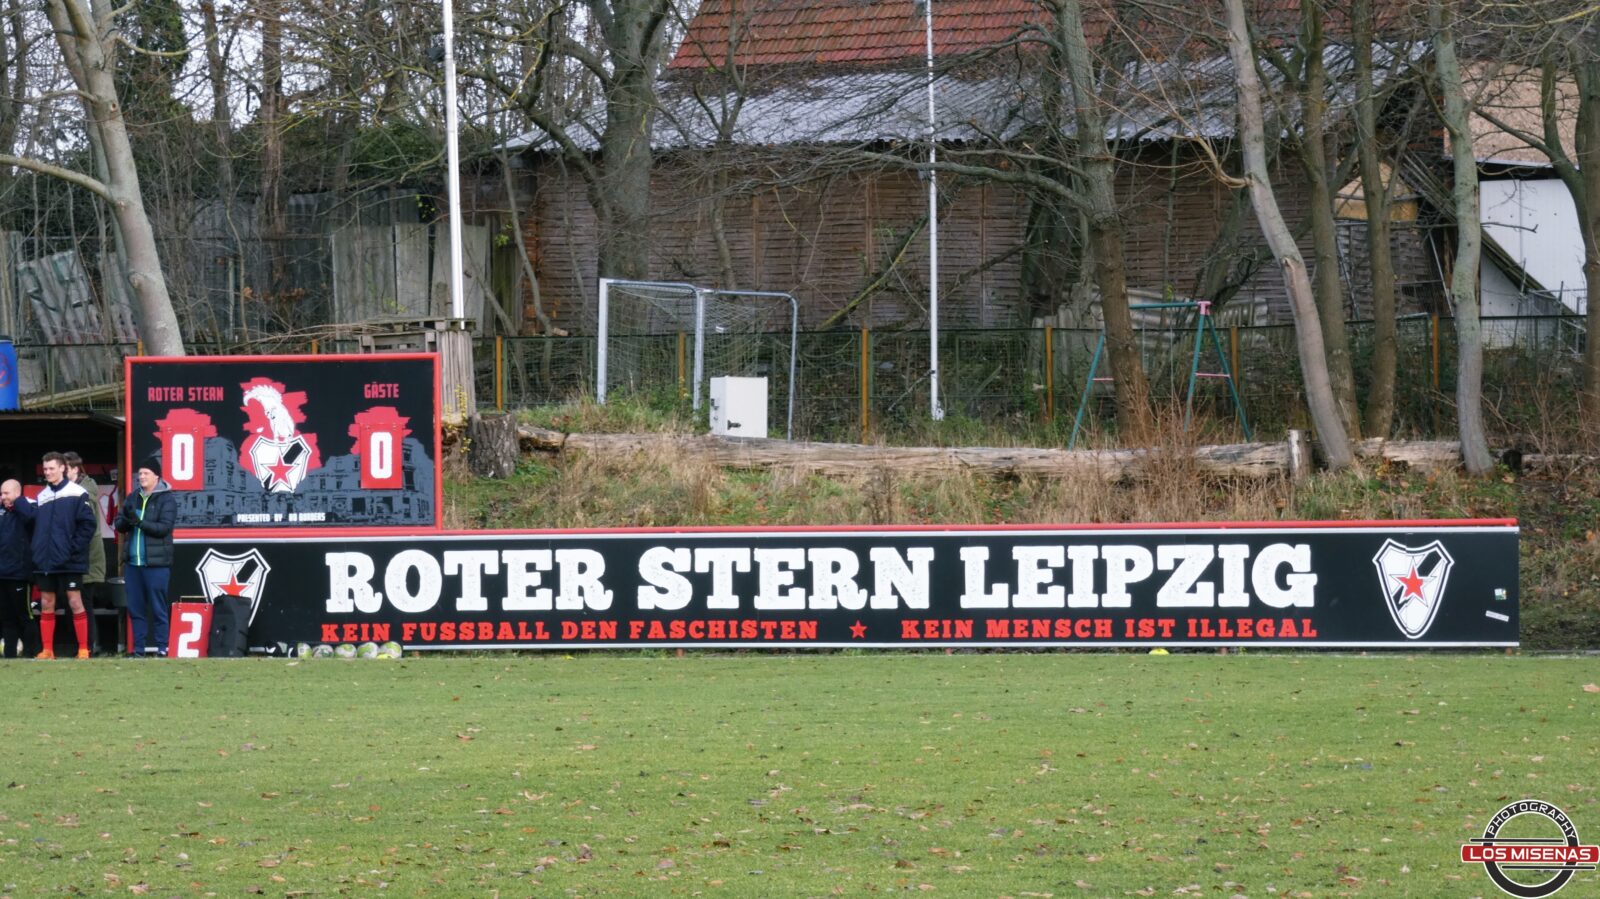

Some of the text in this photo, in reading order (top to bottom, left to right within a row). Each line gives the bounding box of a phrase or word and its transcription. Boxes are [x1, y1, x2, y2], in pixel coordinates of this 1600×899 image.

[148, 387, 224, 401] ROTER STERN
[364, 381, 399, 399] GÄSTE
[172, 433, 194, 480] 0
[370, 431, 392, 479] 0
[325, 543, 1318, 613] ROTER STERN LEIPZIG
[177, 613, 203, 657] 2
[321, 618, 1318, 642] KEIN FUSSBALL DEN FASCHISTEN KEIN MENSCH IST ILLEGAL
